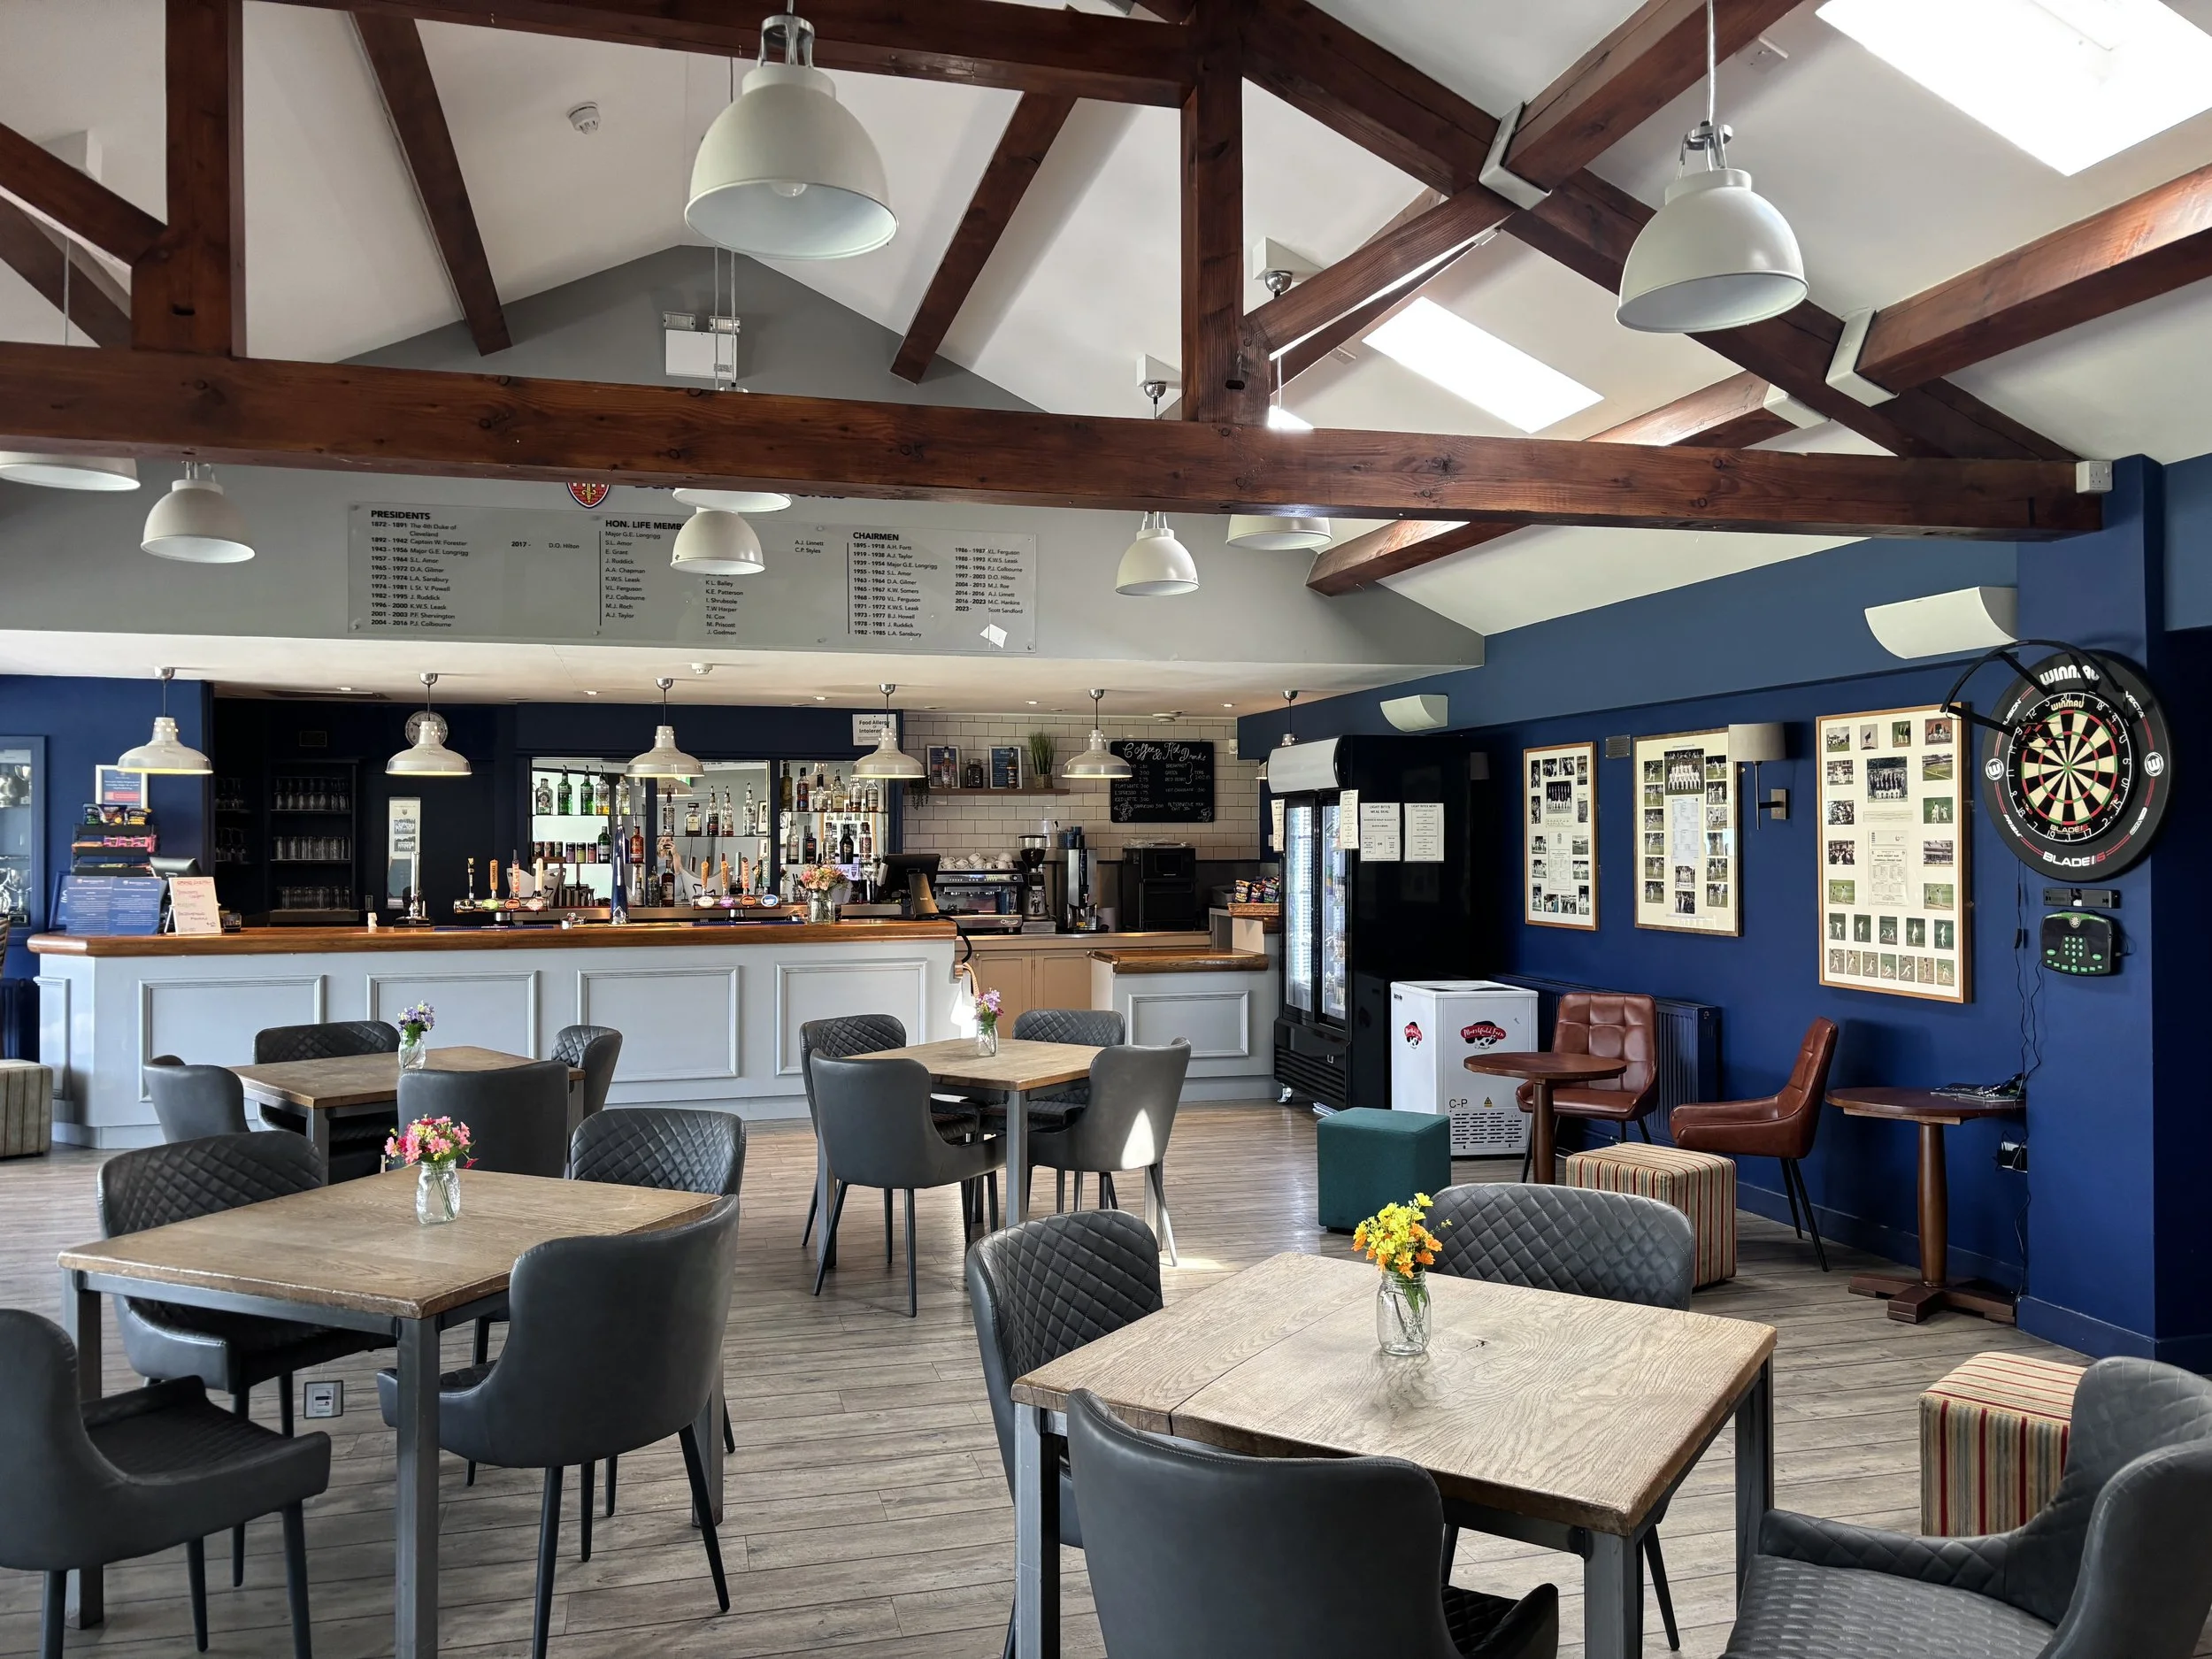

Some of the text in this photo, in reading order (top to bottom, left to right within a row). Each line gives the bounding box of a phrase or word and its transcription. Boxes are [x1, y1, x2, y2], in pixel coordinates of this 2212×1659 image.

[372, 511, 430, 519] PRESIDENTS
[2051, 700, 2084, 710] WINMAU
[2002, 698, 2022, 725] USION
[1123, 742, 1155, 760] Coffee
[1153, 749, 1162, 760] &
[1163, 742, 1180, 760] Hot
[1449, 1099, 1467, 1108] C-P
